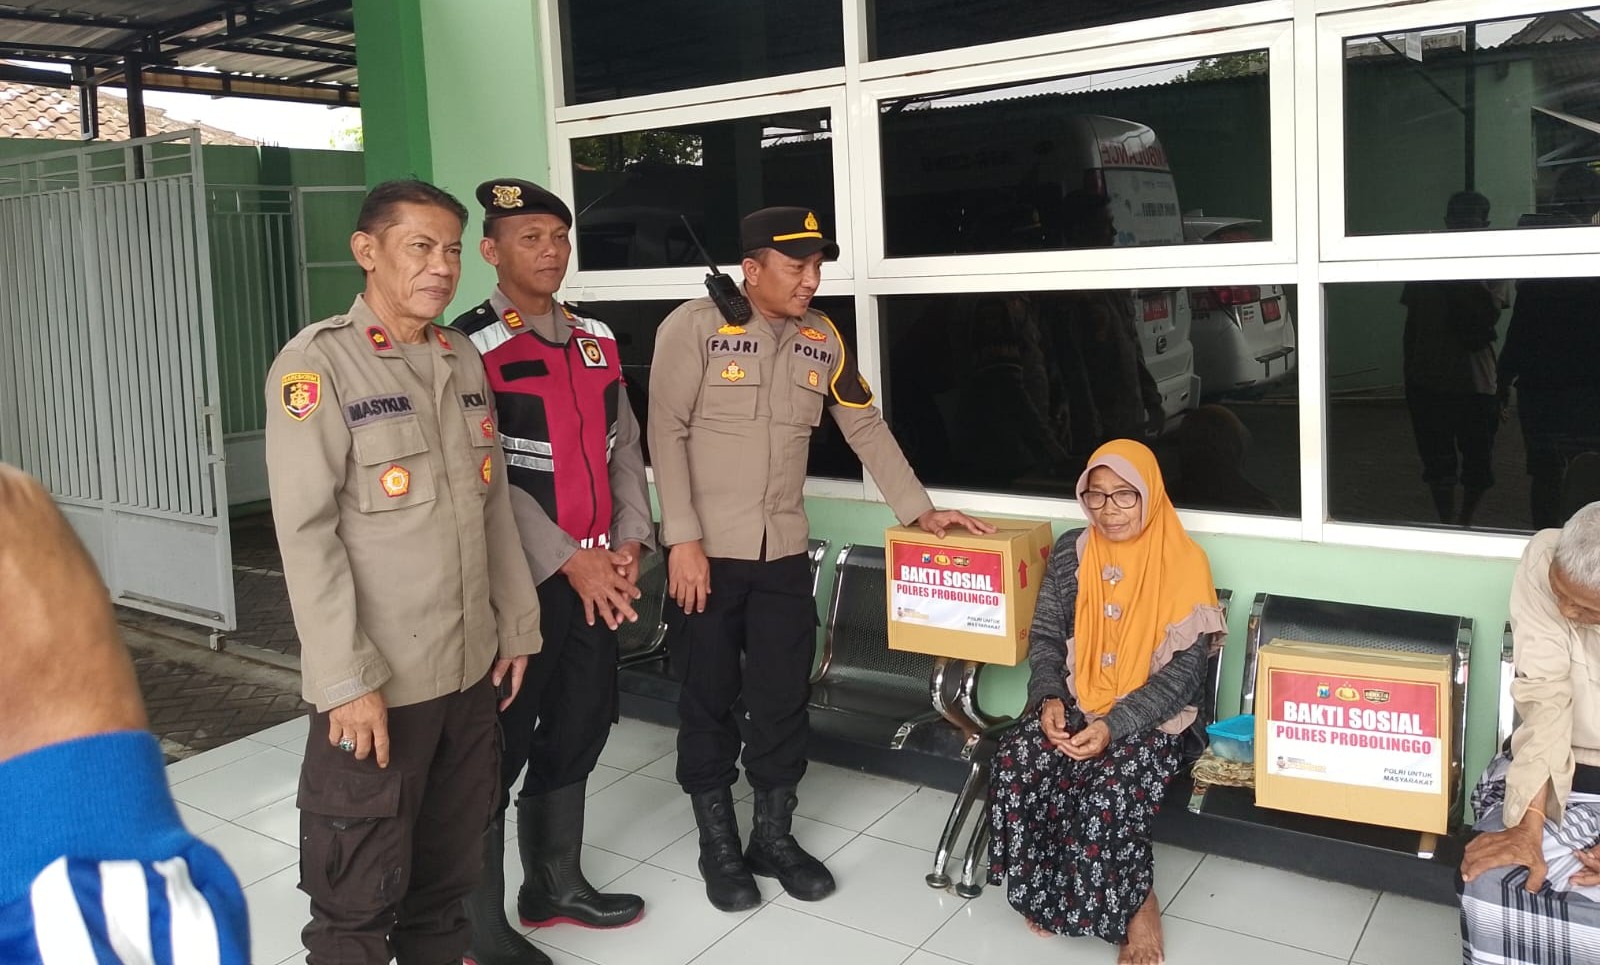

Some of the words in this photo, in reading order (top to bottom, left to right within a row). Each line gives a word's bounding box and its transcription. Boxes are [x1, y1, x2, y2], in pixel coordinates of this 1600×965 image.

[710, 339, 759, 353] FAJRI
[794, 343, 832, 364] POLRI
[348, 396, 412, 422] MASYKUR
[900, 564, 941, 586] BAKTI
[943, 569, 994, 591] SOSIAL
[896, 584, 929, 597] POLRES
[931, 588, 999, 606] PROBOLINGGO
[1283, 700, 1344, 726] BAKTI
[1348, 708, 1423, 735] SOSIAL
[1276, 724, 1327, 744] POLRES
[1331, 730, 1432, 755] PROBOLINGGO
[1383, 767, 1407, 776] POLRI
[1407, 769, 1432, 778] UNTUK
[1383, 775, 1433, 786] MASYARAKAT
